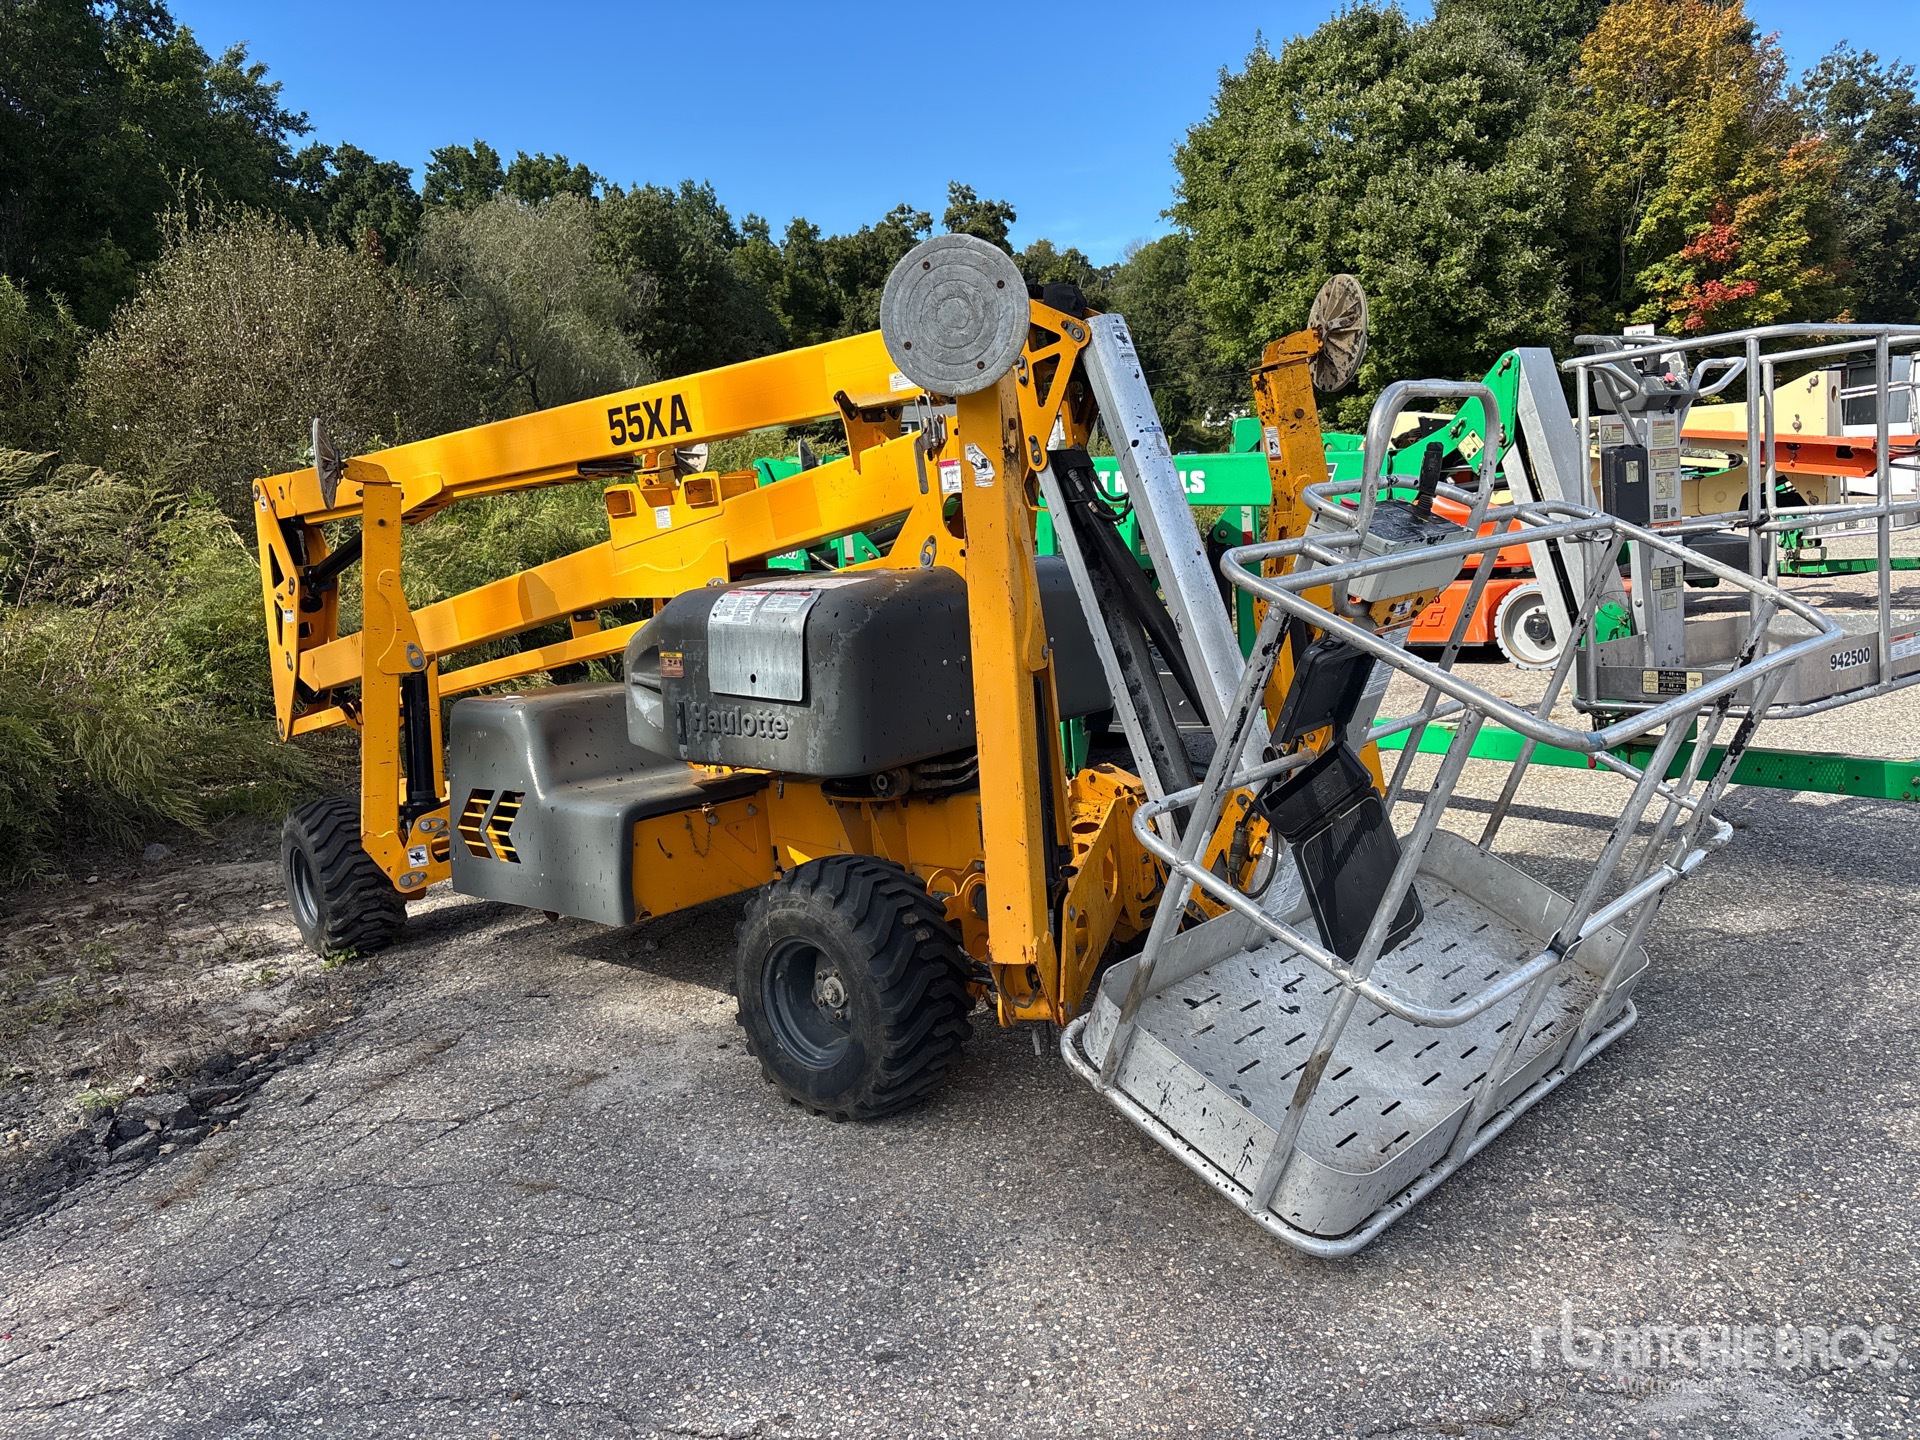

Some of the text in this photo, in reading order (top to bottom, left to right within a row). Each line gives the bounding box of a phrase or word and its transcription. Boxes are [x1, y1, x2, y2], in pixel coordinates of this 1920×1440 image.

[607, 393, 693, 446] 55XA
[1830, 647, 1870, 670] 942500
[690, 701, 789, 741] Haulotte
